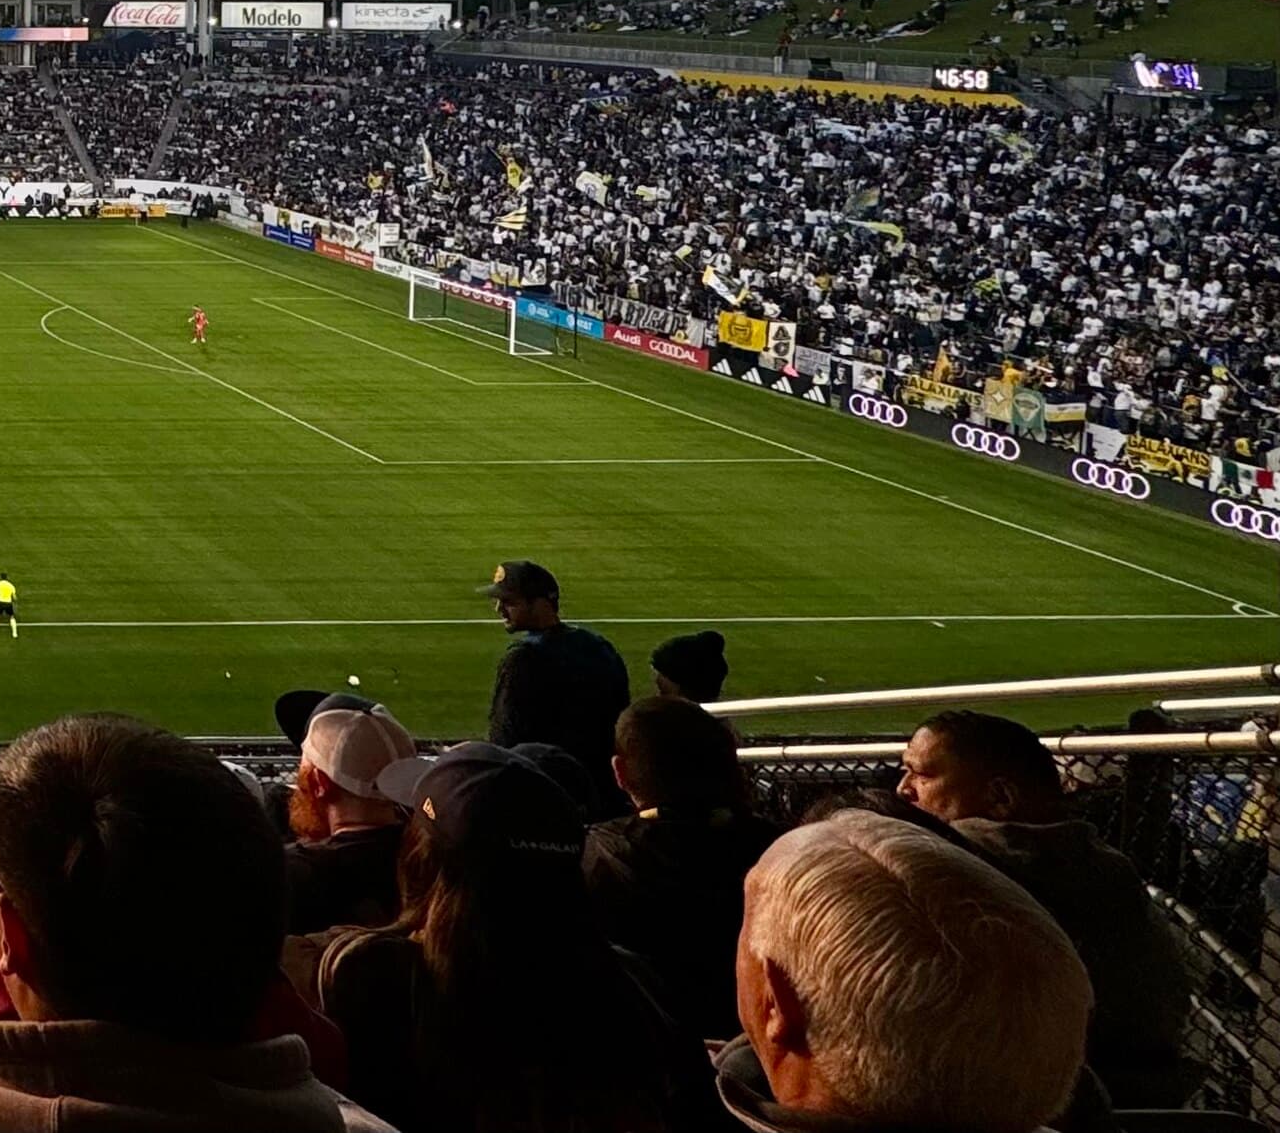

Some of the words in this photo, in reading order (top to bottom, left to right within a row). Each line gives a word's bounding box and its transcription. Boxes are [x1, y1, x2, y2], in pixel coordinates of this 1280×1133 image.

[112, 2, 180, 26] Coca-Cola
[241, 7, 302, 27] Modelo
[354, 4, 410, 18] kinecta
[934, 68, 989, 90] 46:58
[613, 329, 641, 346] Audi
[1127, 434, 1210, 467] GALAXIANS
